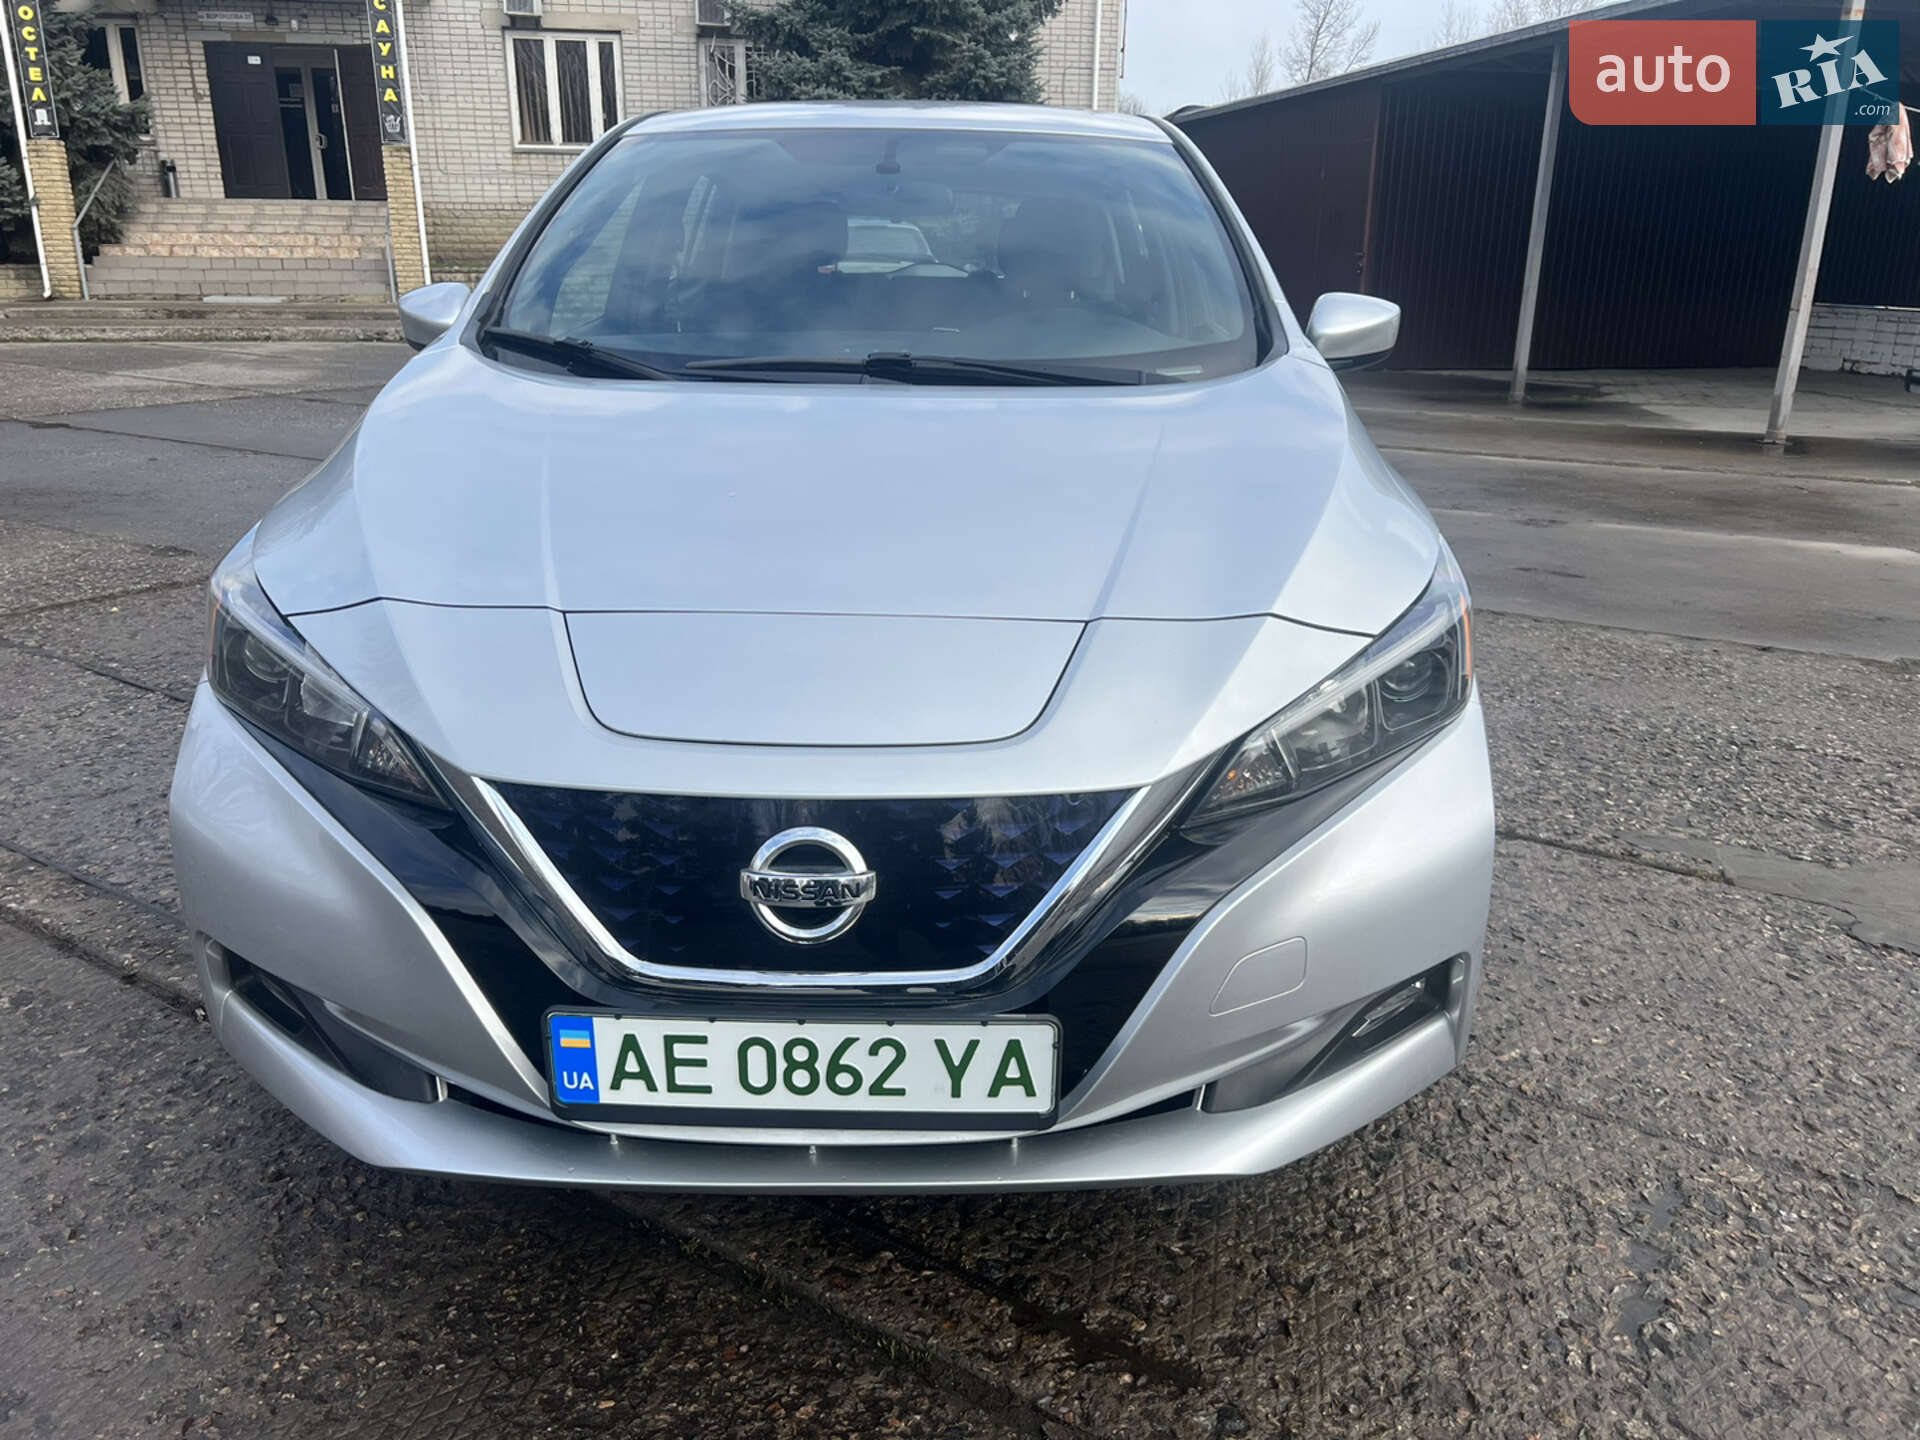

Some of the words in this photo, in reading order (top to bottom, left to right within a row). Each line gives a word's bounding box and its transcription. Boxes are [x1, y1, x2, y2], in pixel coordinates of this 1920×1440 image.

[373, 0, 398, 102] САУНА
[752, 877, 861, 902] NISSAN
[563, 1071, 595, 1091] UA
[609, 1033, 713, 1094] AE
[737, 1036, 907, 1096] 0862
[934, 1038, 1037, 1098] YA
